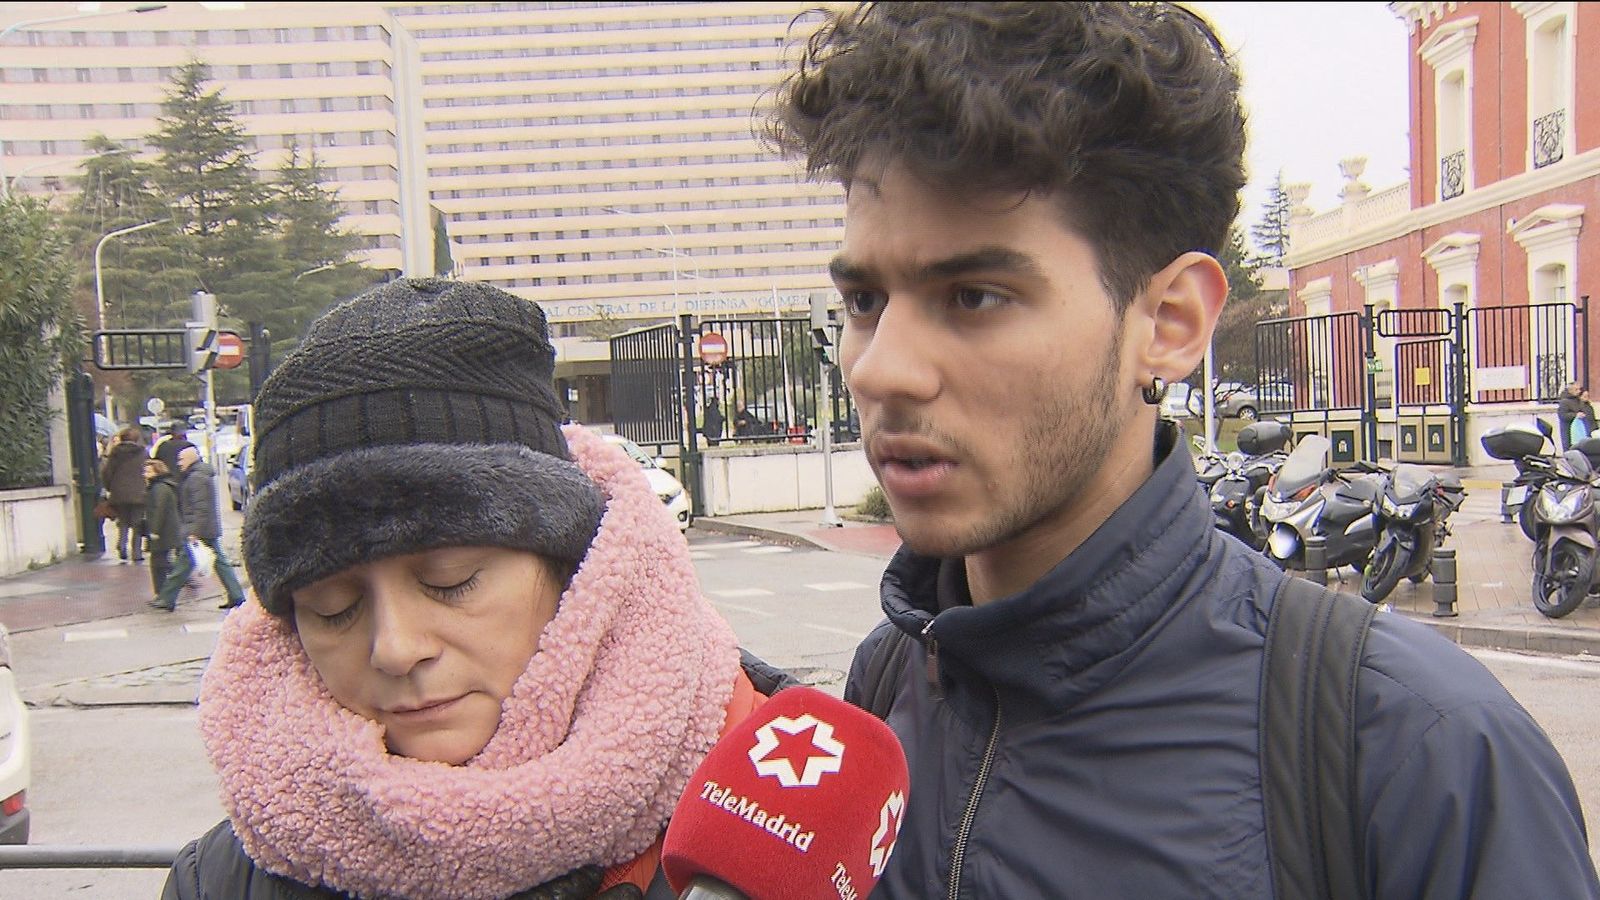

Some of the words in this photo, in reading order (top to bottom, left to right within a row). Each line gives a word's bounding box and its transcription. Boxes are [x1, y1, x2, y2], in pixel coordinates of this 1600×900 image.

[567, 302, 632, 316] CENTRAL
[639, 301, 656, 313] DE
[663, 300, 678, 312] LA
[685, 297, 748, 311] DEFENSA
[700, 781, 815, 853] TeleMadrid
